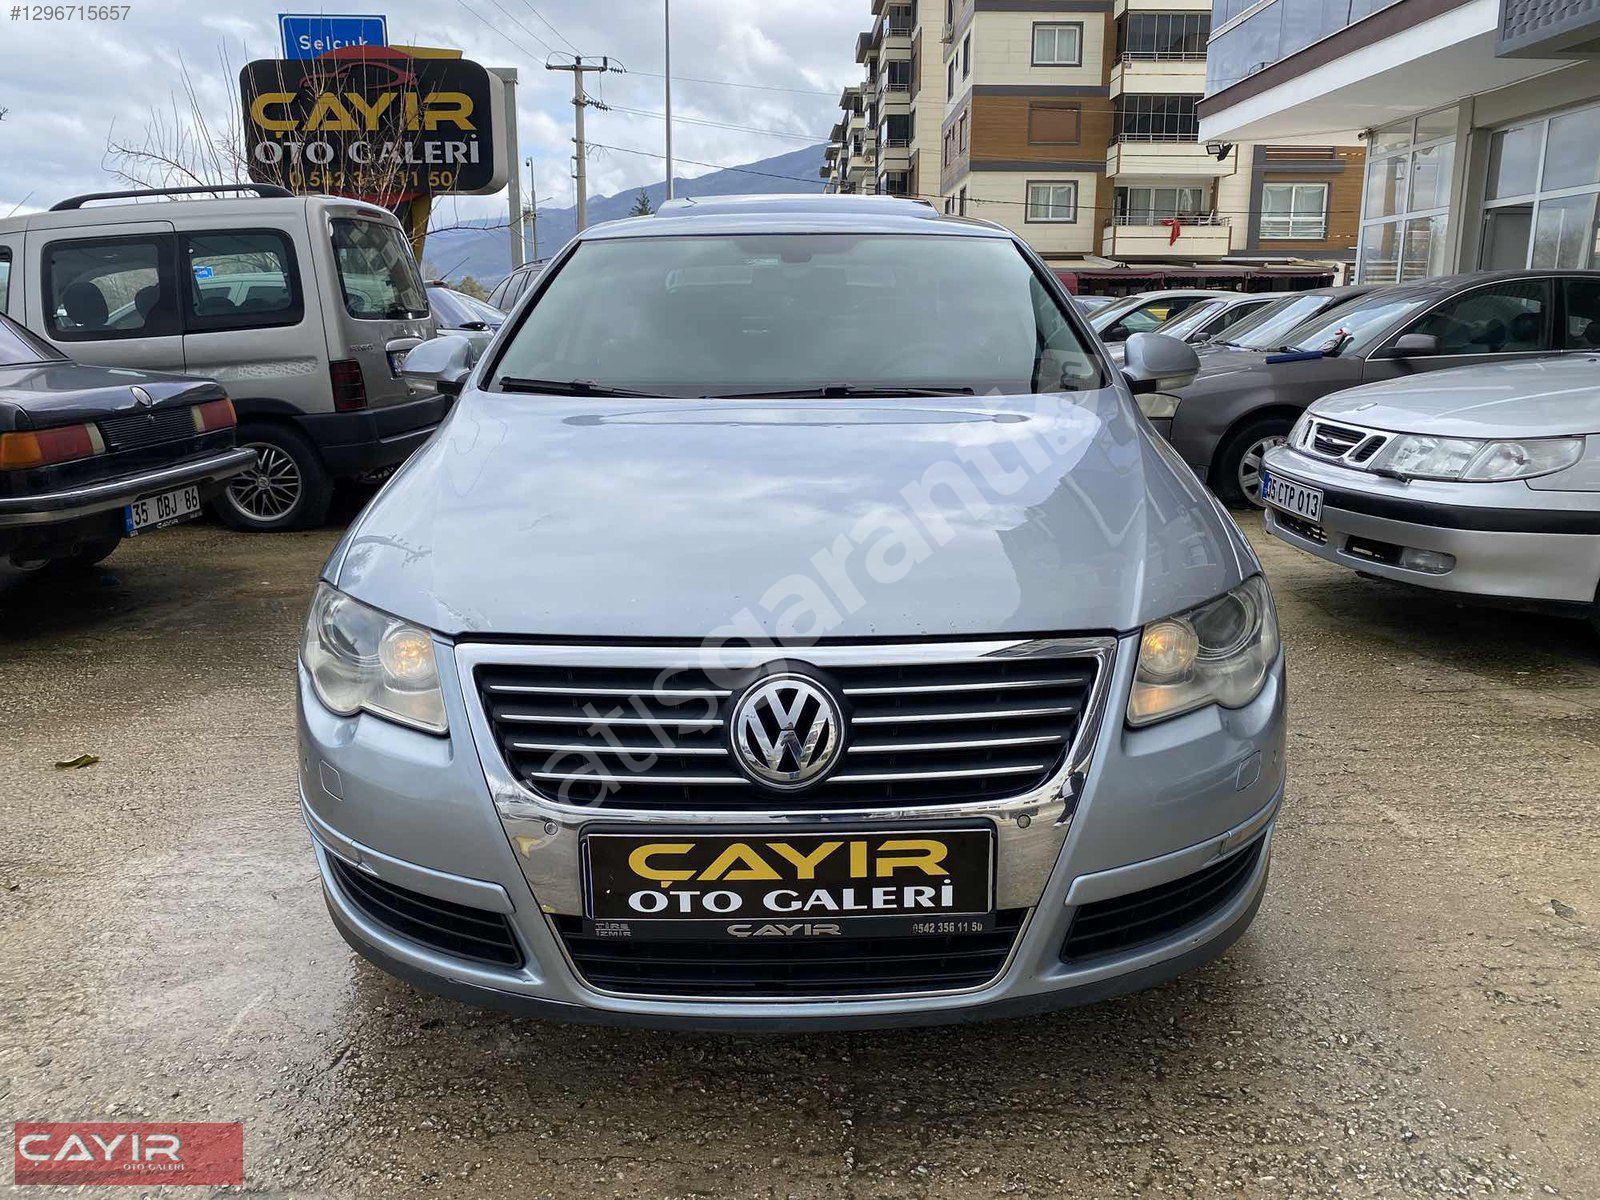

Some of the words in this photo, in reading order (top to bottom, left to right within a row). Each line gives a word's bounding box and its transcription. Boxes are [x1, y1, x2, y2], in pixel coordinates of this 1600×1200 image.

[251, 92, 477, 138] ÇAYIR
[255, 141, 334, 164] OTO
[348, 134, 480, 164] GALERİ
[428, 171, 453, 187] 50
[133, 502, 148, 526] 35
[157, 494, 178, 519] DBJ
[185, 488, 197, 509] 86
[1278, 482, 1296, 507] CTP
[1297, 490, 1319, 517] 013
[628, 839, 951, 888] ÇAYIR
[628, 890, 743, 913] OTO
[762, 879, 953, 911] GALERİ
[938, 922, 955, 932] 356
[957, 922, 968, 932] 11
